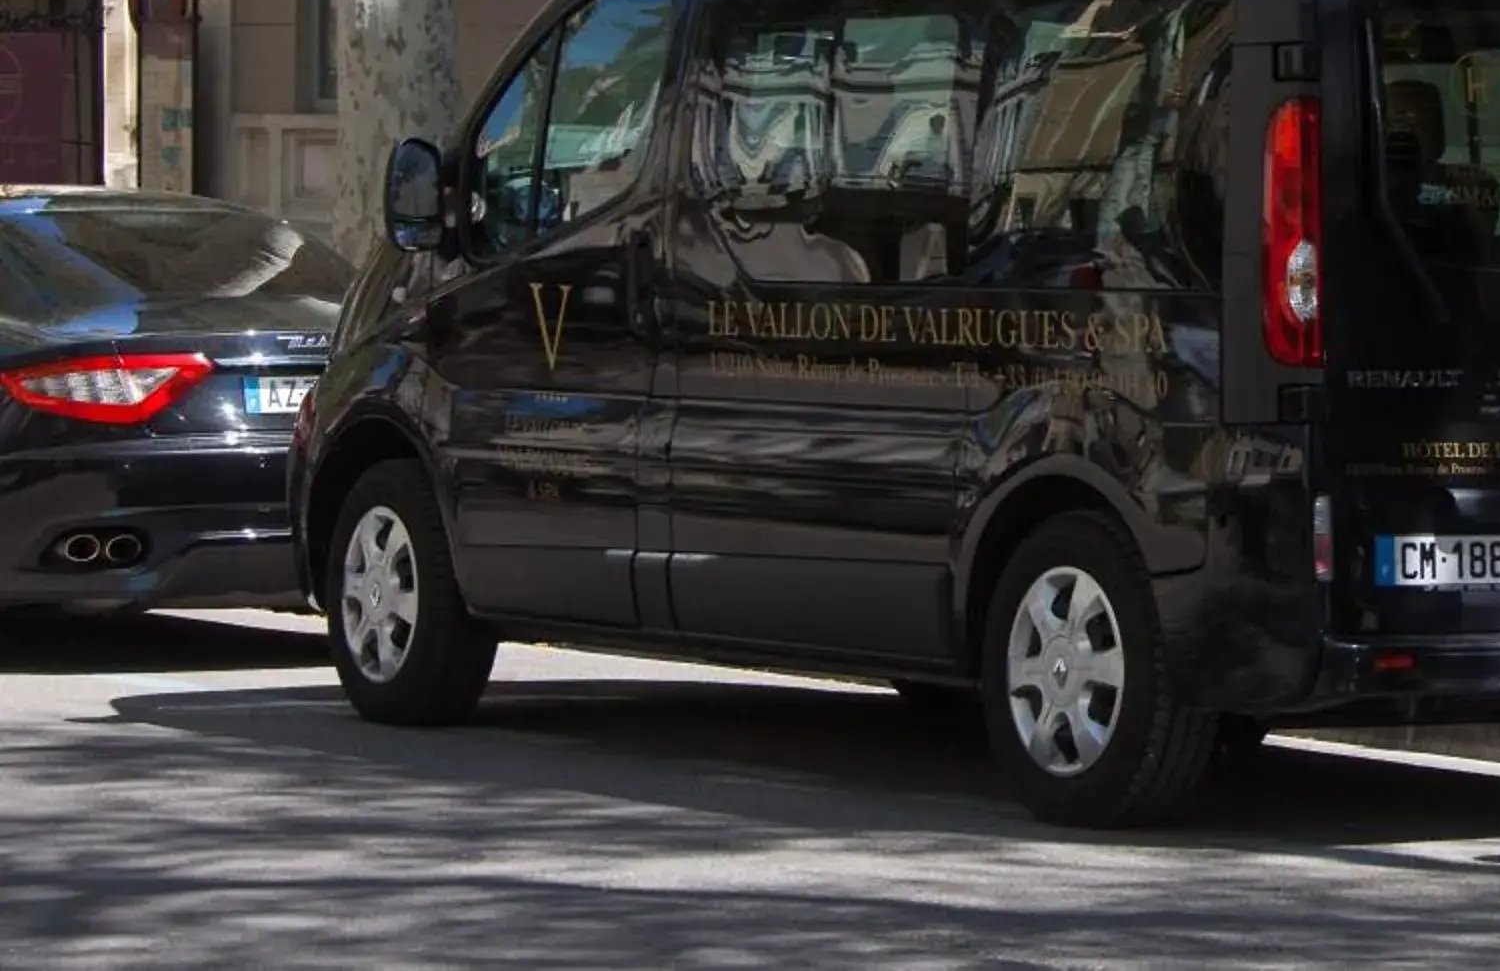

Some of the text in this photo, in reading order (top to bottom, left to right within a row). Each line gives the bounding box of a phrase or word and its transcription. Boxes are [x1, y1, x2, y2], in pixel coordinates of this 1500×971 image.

[529, 283, 573, 370] V
[708, 300, 1168, 354] LE VALLON DE VALRUGUES & SPA
[1346, 370, 1464, 388] RENAULT
[1469, 442, 1490, 459] DE
